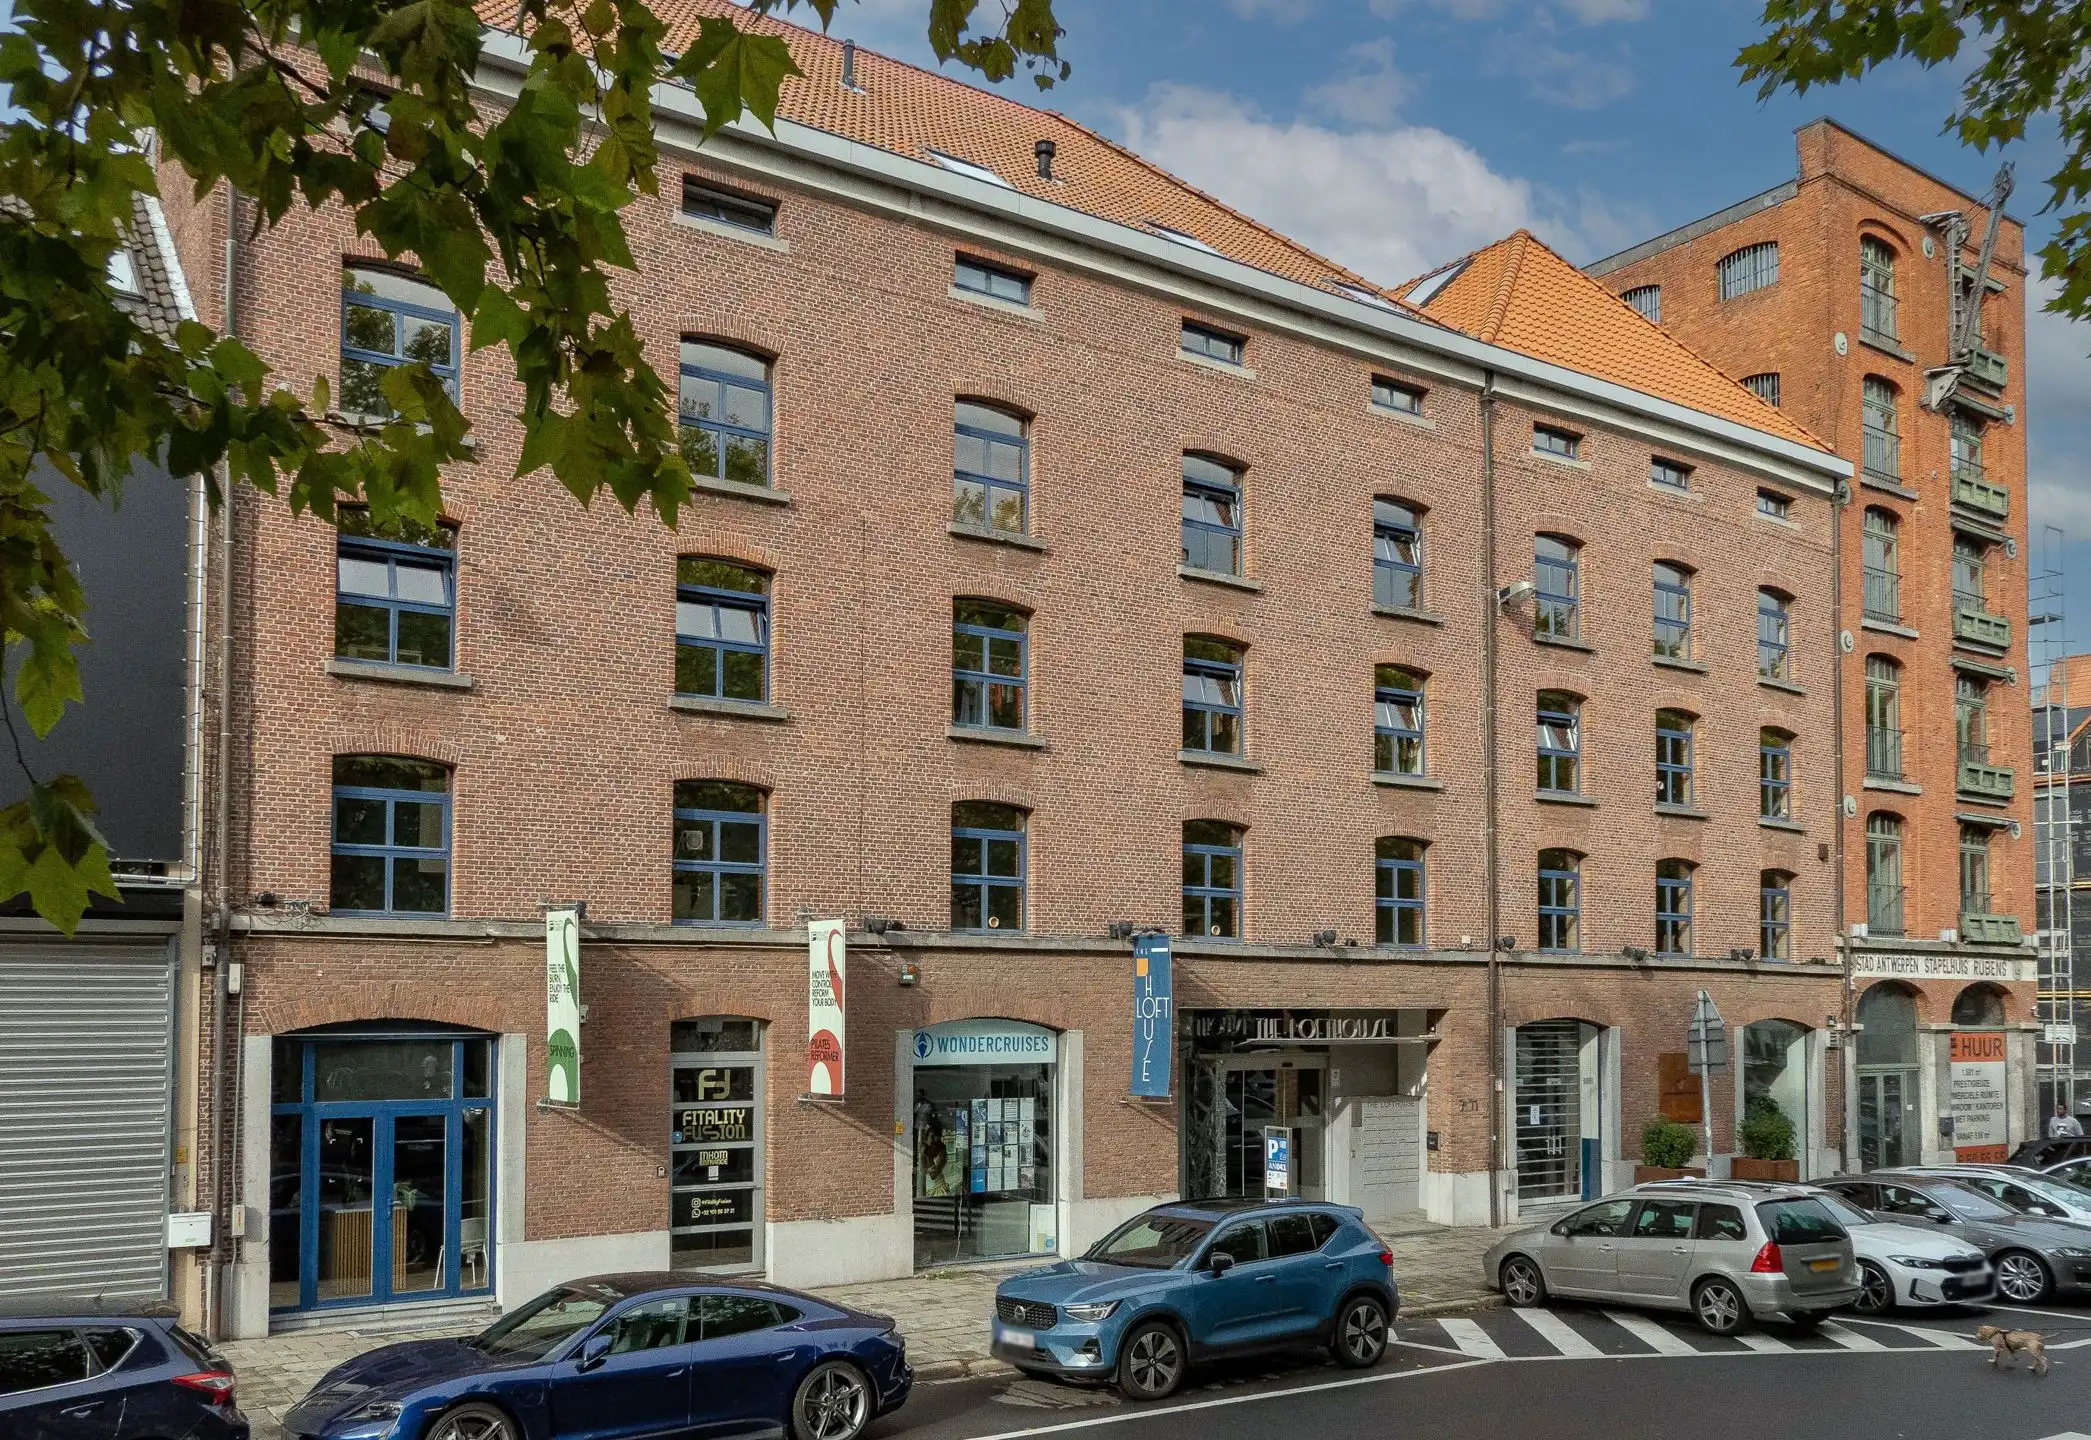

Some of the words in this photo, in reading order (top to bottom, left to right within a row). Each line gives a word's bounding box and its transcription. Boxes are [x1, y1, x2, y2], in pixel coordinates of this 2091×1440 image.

[1856, 955, 1874, 972] STAD
[1876, 957, 1919, 973] ANTWERPEN
[1924, 958, 1969, 975] STAPELHUIS
[1973, 960, 2007, 977] RUBENS
[812, 970, 825, 979] MOVE
[812, 989, 829, 998] REFORM
[812, 998, 825, 1007] YOUR
[1136, 997, 1170, 1019] LOFT
[549, 1044, 575, 1058] SPINNING
[811, 1038, 831, 1050] PILATES
[937, 1036, 1049, 1053] WONDERCRUISES
[1962, 1037, 2004, 1058] HUUR
[810, 1050, 840, 1062] REFORMER
[682, 1109, 745, 1125] FITALITY
[682, 1123, 746, 1141] FUSION
[1267, 1138, 1279, 1159] P
